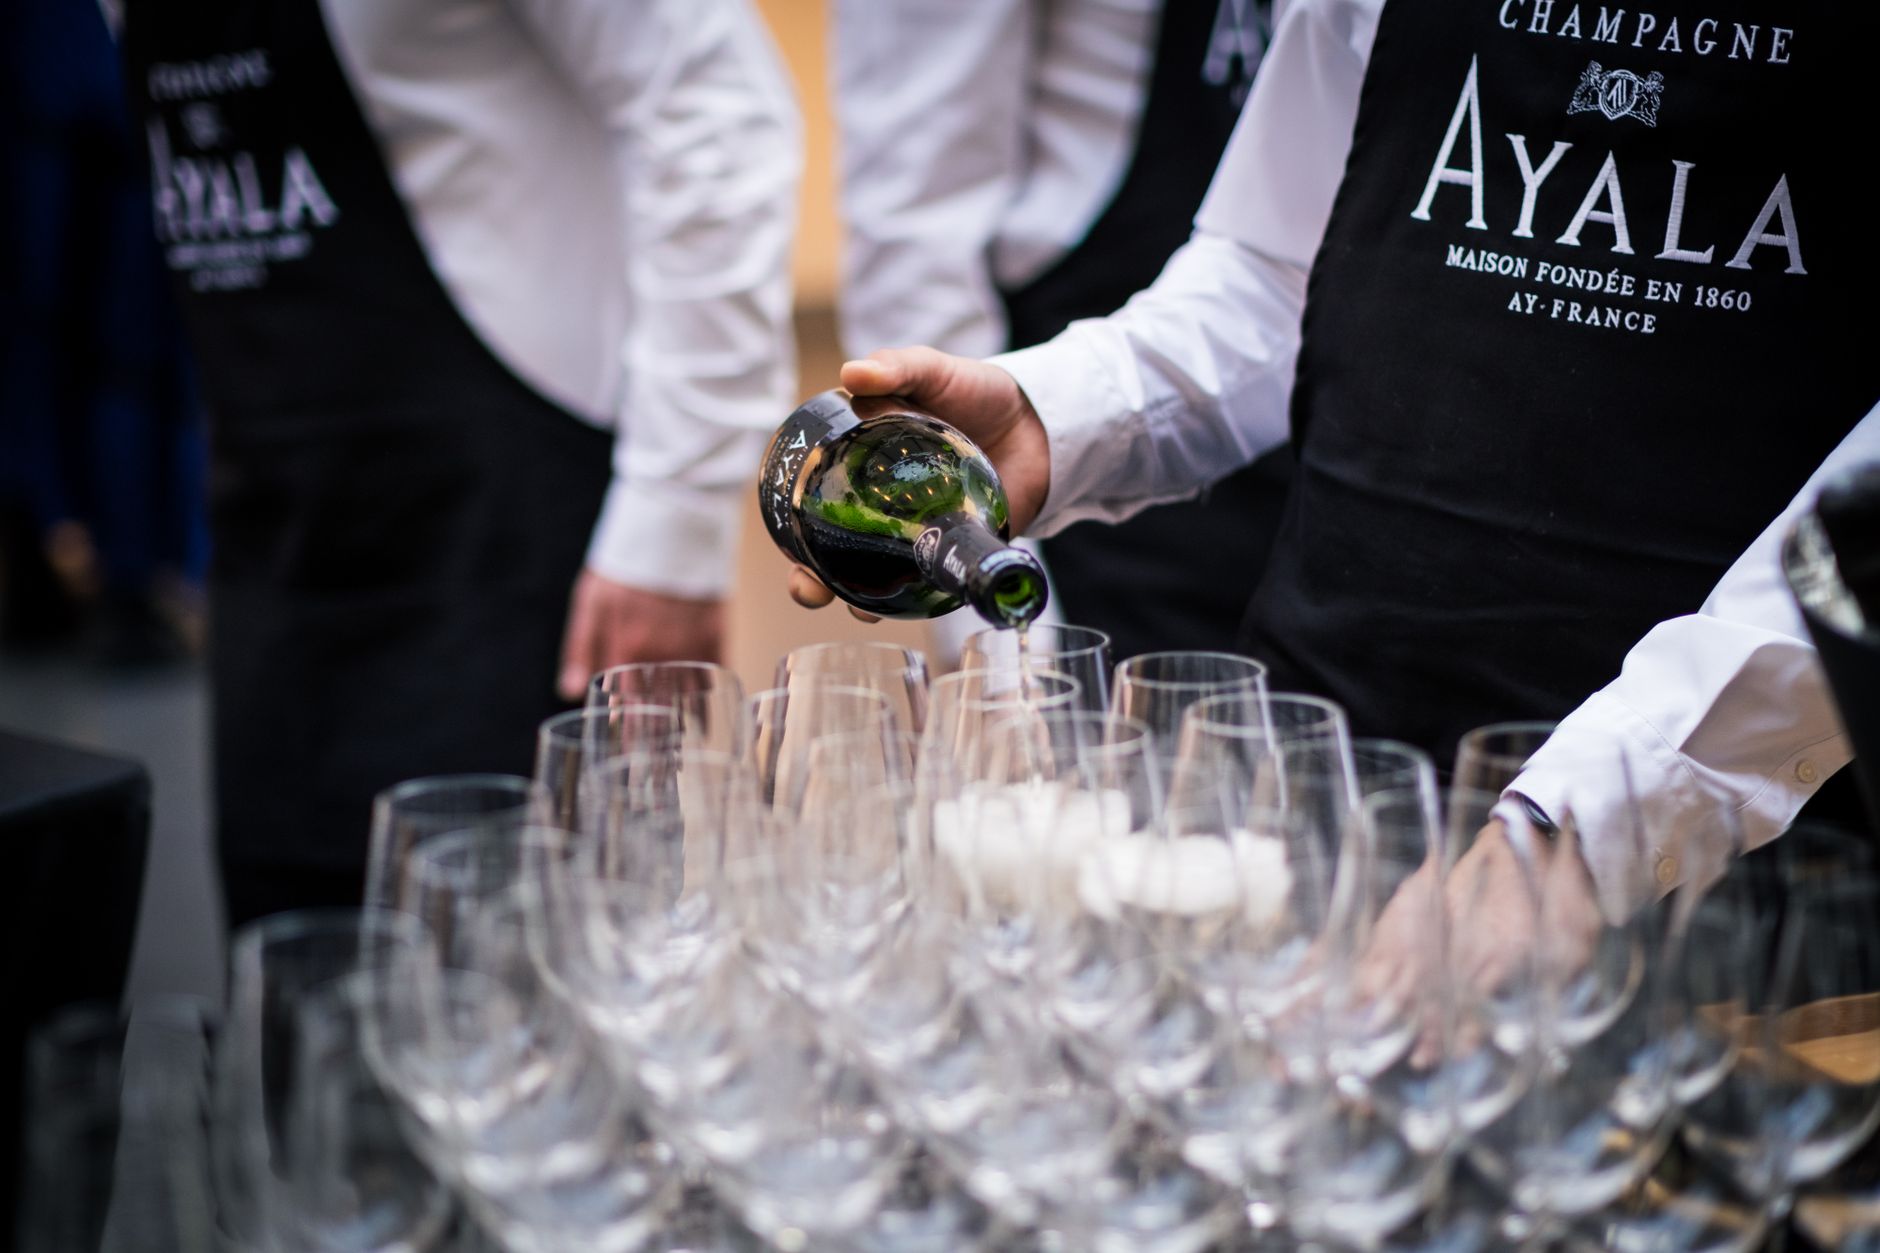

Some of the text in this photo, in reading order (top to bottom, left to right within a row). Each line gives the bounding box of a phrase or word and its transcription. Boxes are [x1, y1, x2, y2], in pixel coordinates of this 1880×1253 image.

[1499, 0, 1794, 64] CHAMPAGNE
[1411, 53, 1808, 275] AYALA
[1445, 243, 1752, 312] MAISON FONDÉE EN 1860
